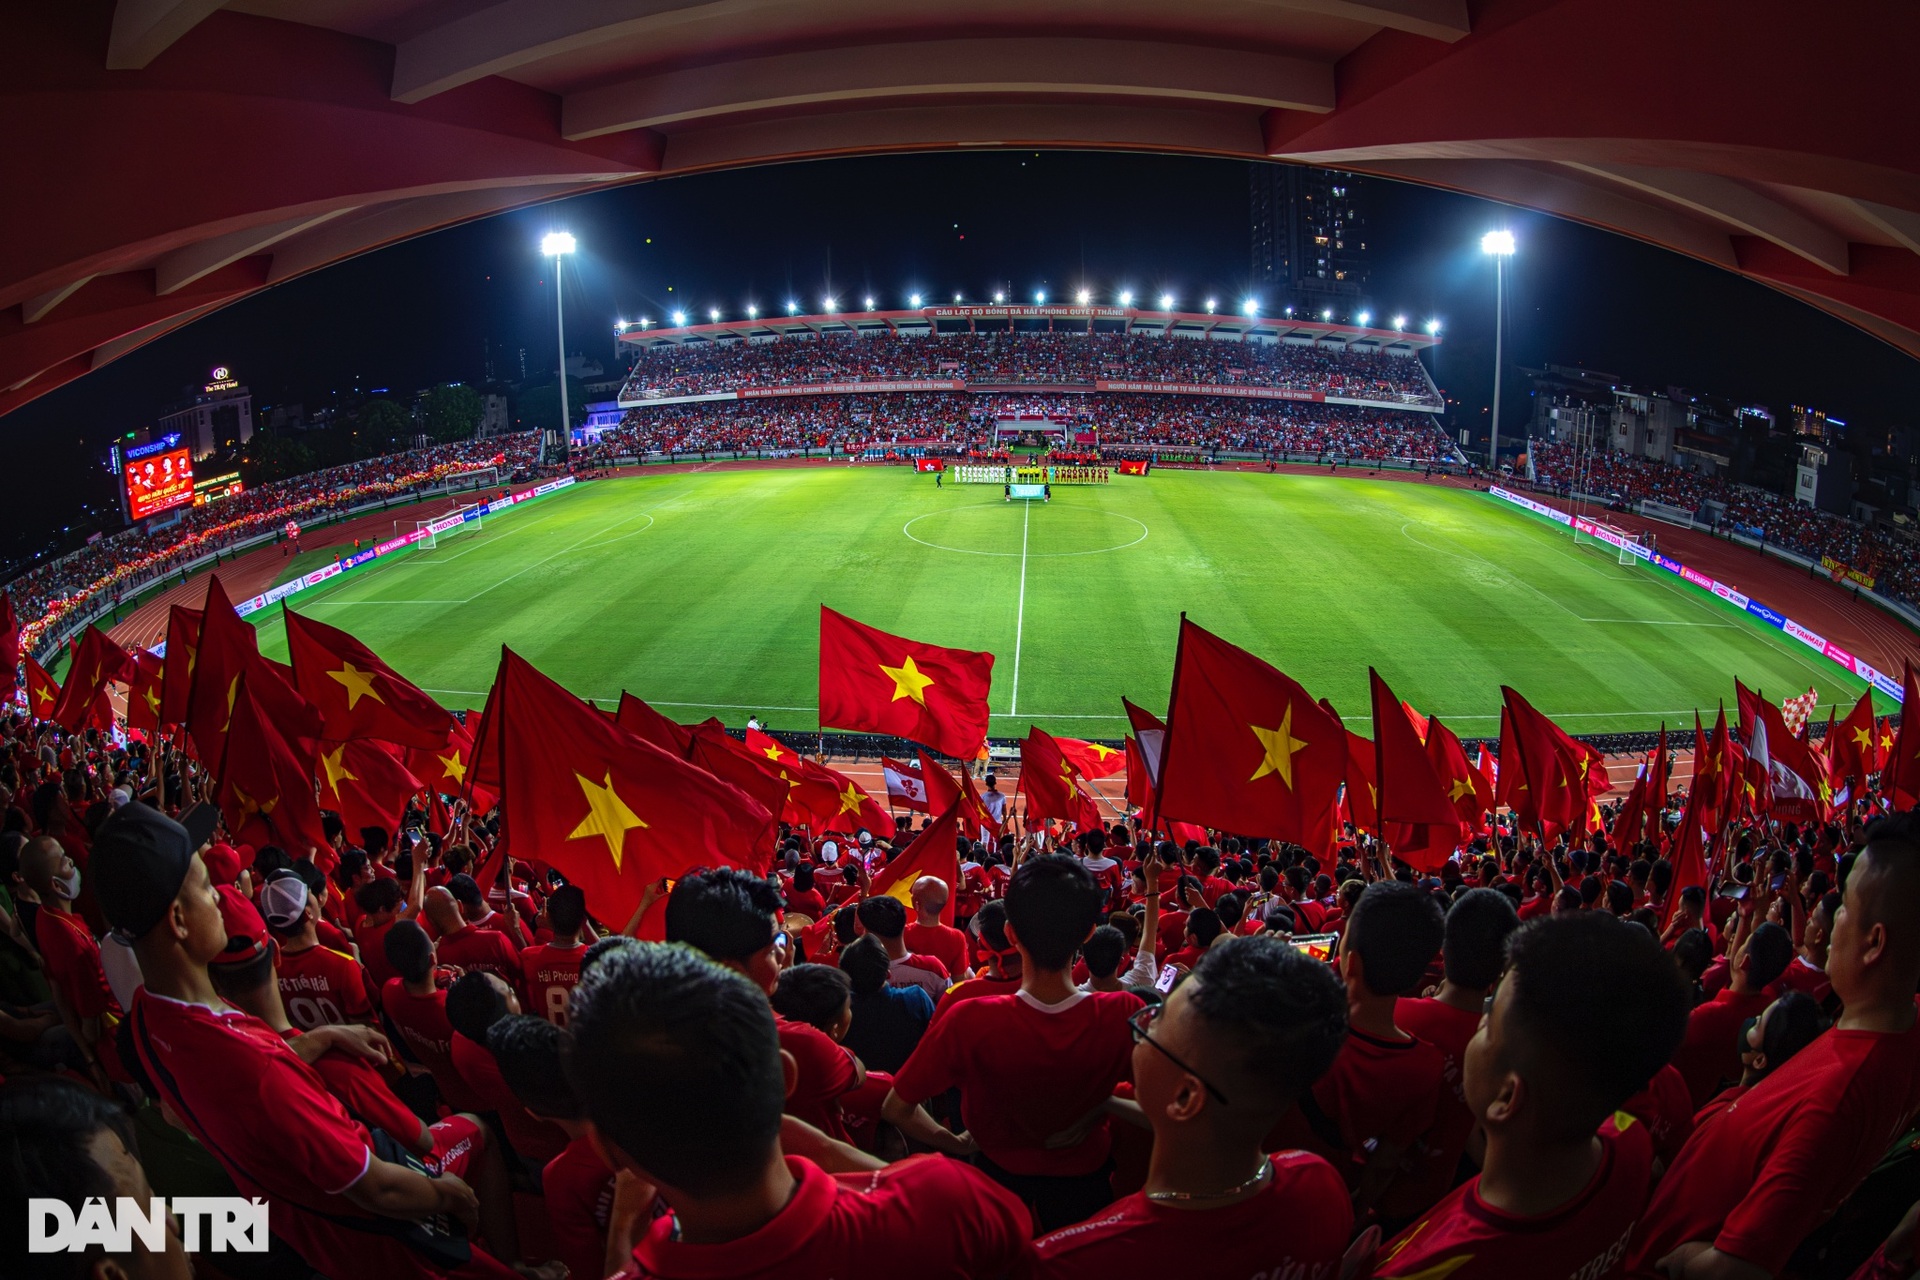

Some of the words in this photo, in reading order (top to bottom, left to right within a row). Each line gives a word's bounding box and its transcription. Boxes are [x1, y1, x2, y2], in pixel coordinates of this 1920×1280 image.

[955, 308, 970, 316] LẠC
[972, 308, 983, 316] BỘ
[1023, 307, 1038, 315] HẢI
[1040, 307, 1068, 315] PHÒNG
[126, 441, 166, 459] VICONSHIP
[204, 494, 212, 503] 0
[224, 488, 231, 496] 0
[436, 516, 463, 532] HONDA
[1595, 529, 1622, 546] HONDA
[1796, 628, 1824, 649] YANMAR
[545, 985, 571, 1030] 8
